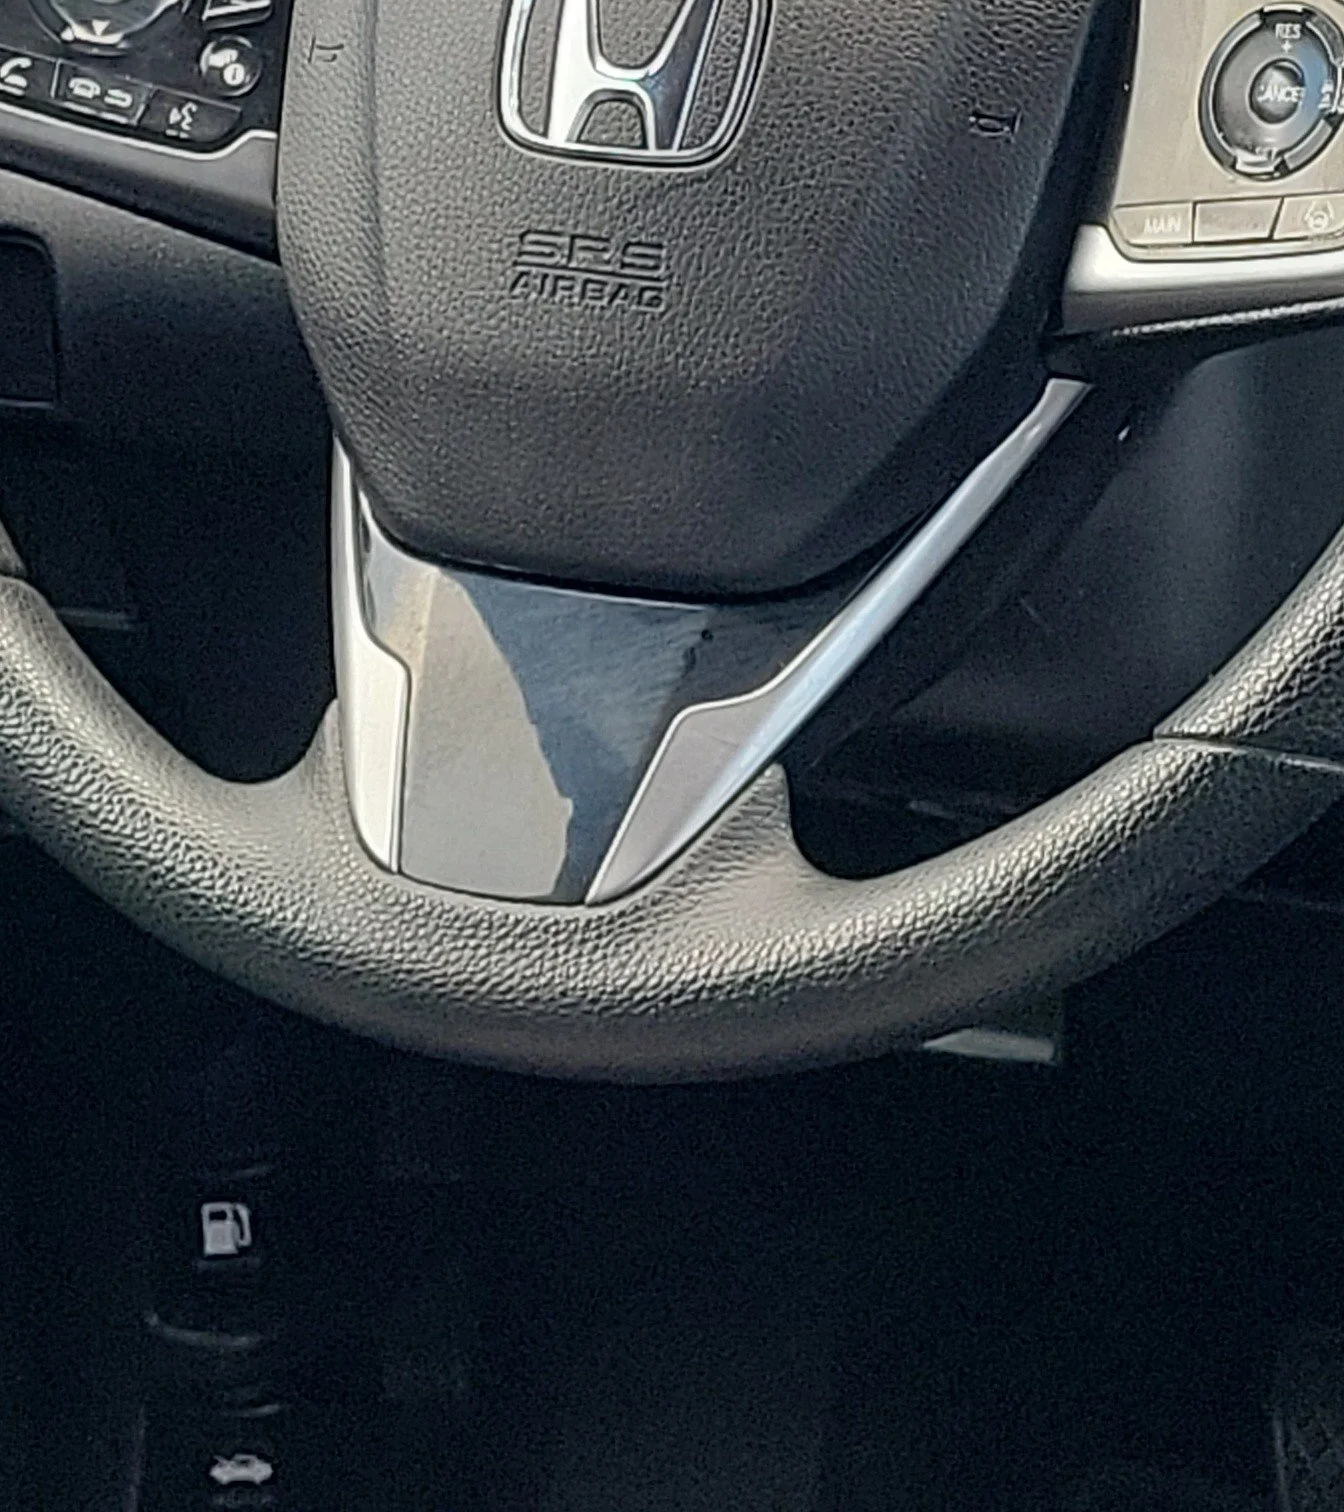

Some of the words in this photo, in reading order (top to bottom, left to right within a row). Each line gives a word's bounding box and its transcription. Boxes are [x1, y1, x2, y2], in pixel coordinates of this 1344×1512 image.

[1275, 23, 1302, 39] RES
[1143, 215, 1182, 235] MAIN
[509, 272, 668, 311] AIRBAG
